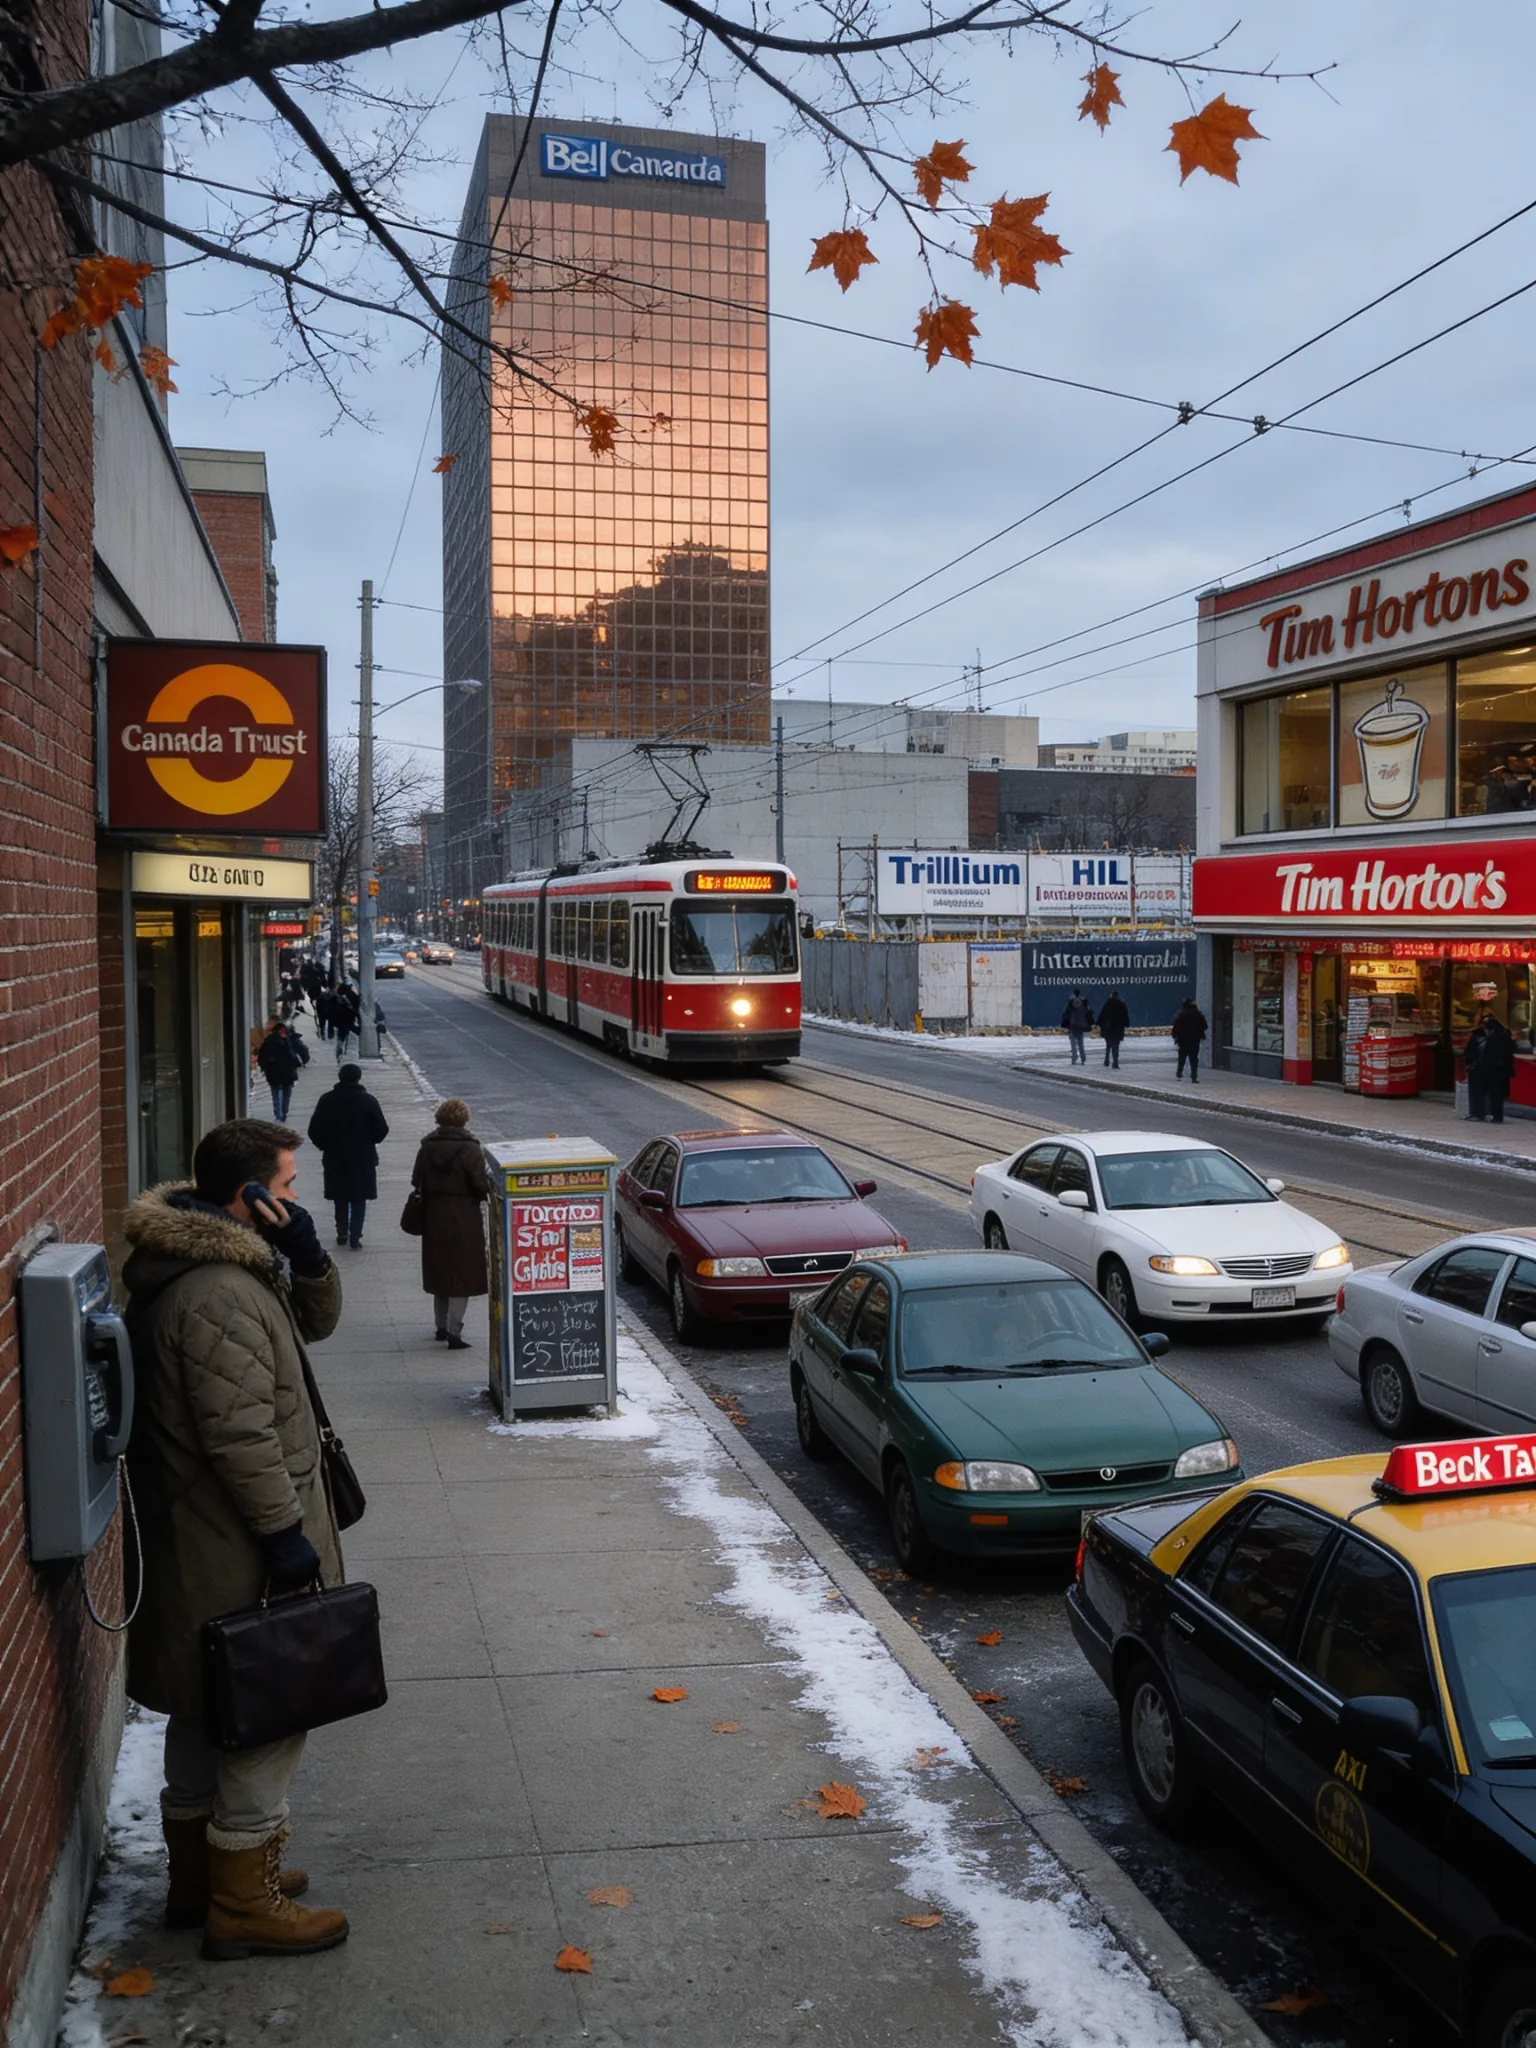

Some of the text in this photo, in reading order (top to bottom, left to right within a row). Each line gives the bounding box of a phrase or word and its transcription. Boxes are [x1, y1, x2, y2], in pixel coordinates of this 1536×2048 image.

[546, 138, 607, 178] Bell
[1260, 558, 1530, 669] Tim Hortons
[121, 724, 307, 755] Canada Trust
[1073, 860, 1128, 885] HIL
[1276, 862, 1343, 912] Tim
[1415, 1446, 1493, 1487] Beck
